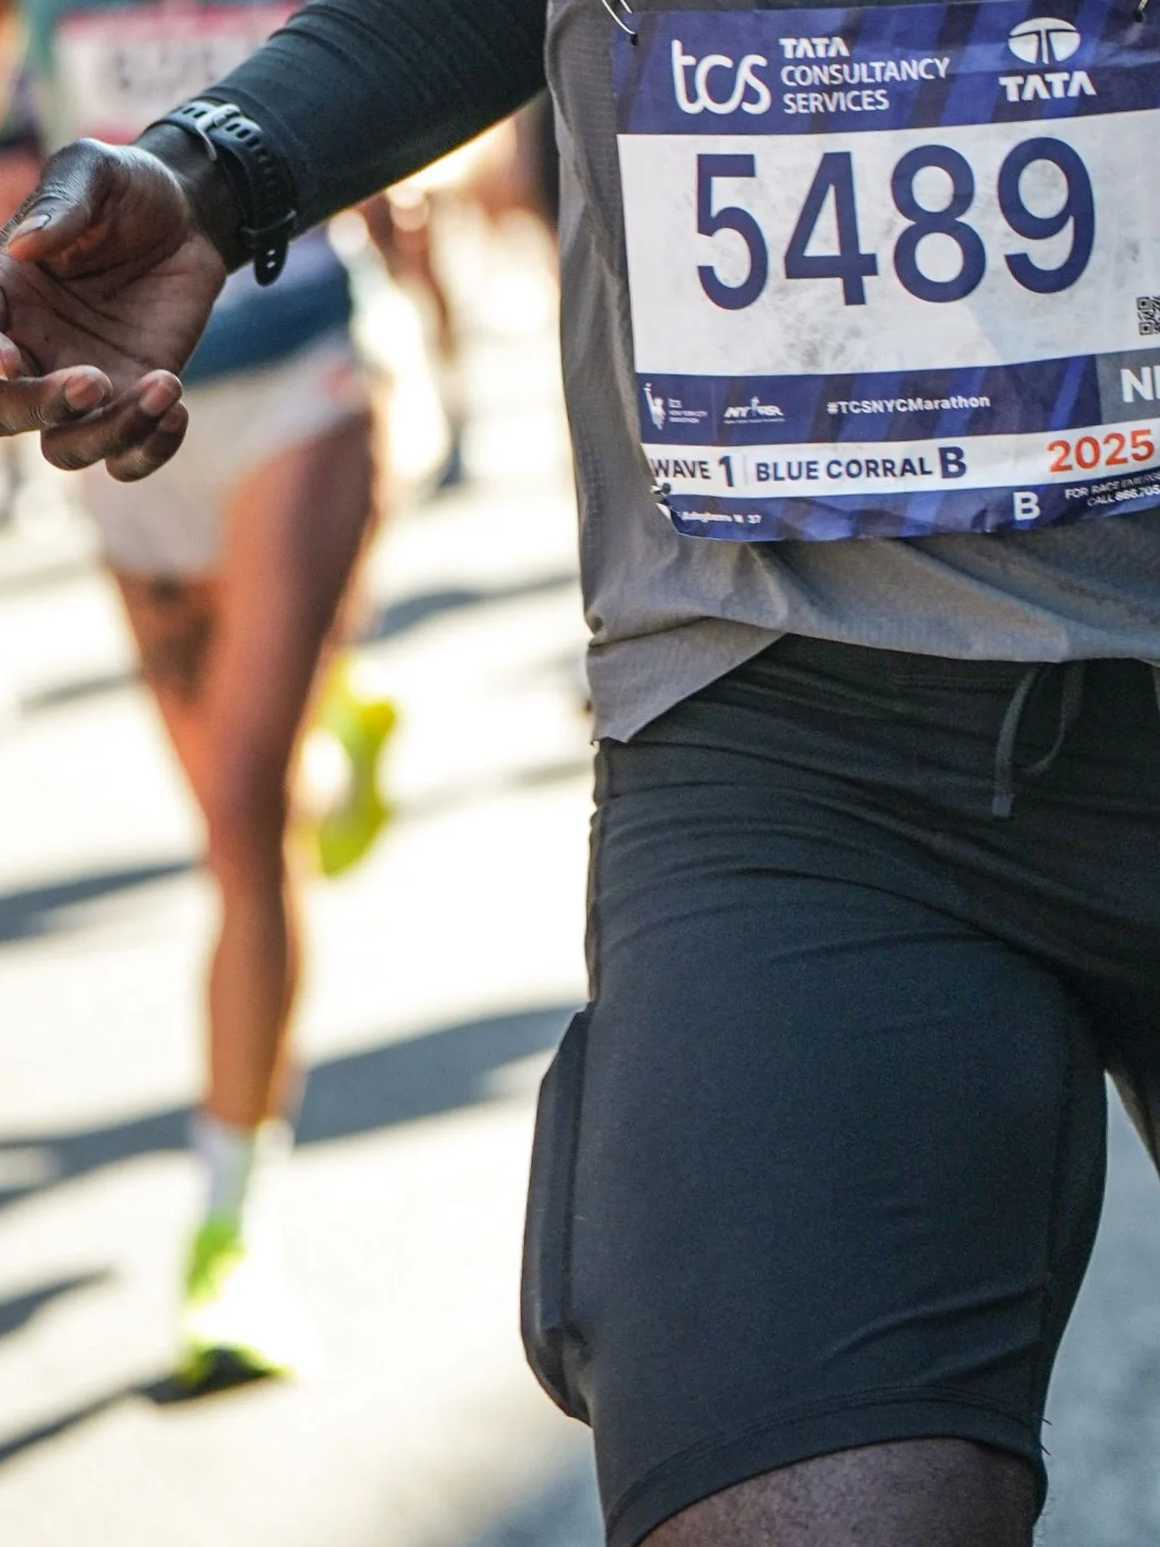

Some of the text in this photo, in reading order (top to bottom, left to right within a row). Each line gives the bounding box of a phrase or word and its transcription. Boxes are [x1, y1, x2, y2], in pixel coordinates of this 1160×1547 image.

[779, 37, 849, 59] TATA
[671, 39, 771, 115] tcs
[781, 57, 950, 87] CONSULTANCY
[999, 70, 1097, 103] TATA
[783, 89, 890, 114] SERVICES
[697, 137, 1095, 310] 5489
[827, 395, 991, 415] #TCSNYCMarathon
[1046, 429, 1155, 472] 2025
[651, 446, 967, 487] WAVE 1 BLUE CORRAL B
[1065, 487, 1088, 499] FOR
[1091, 481, 1120, 494] RACE
[1013, 491, 1041, 520] B
